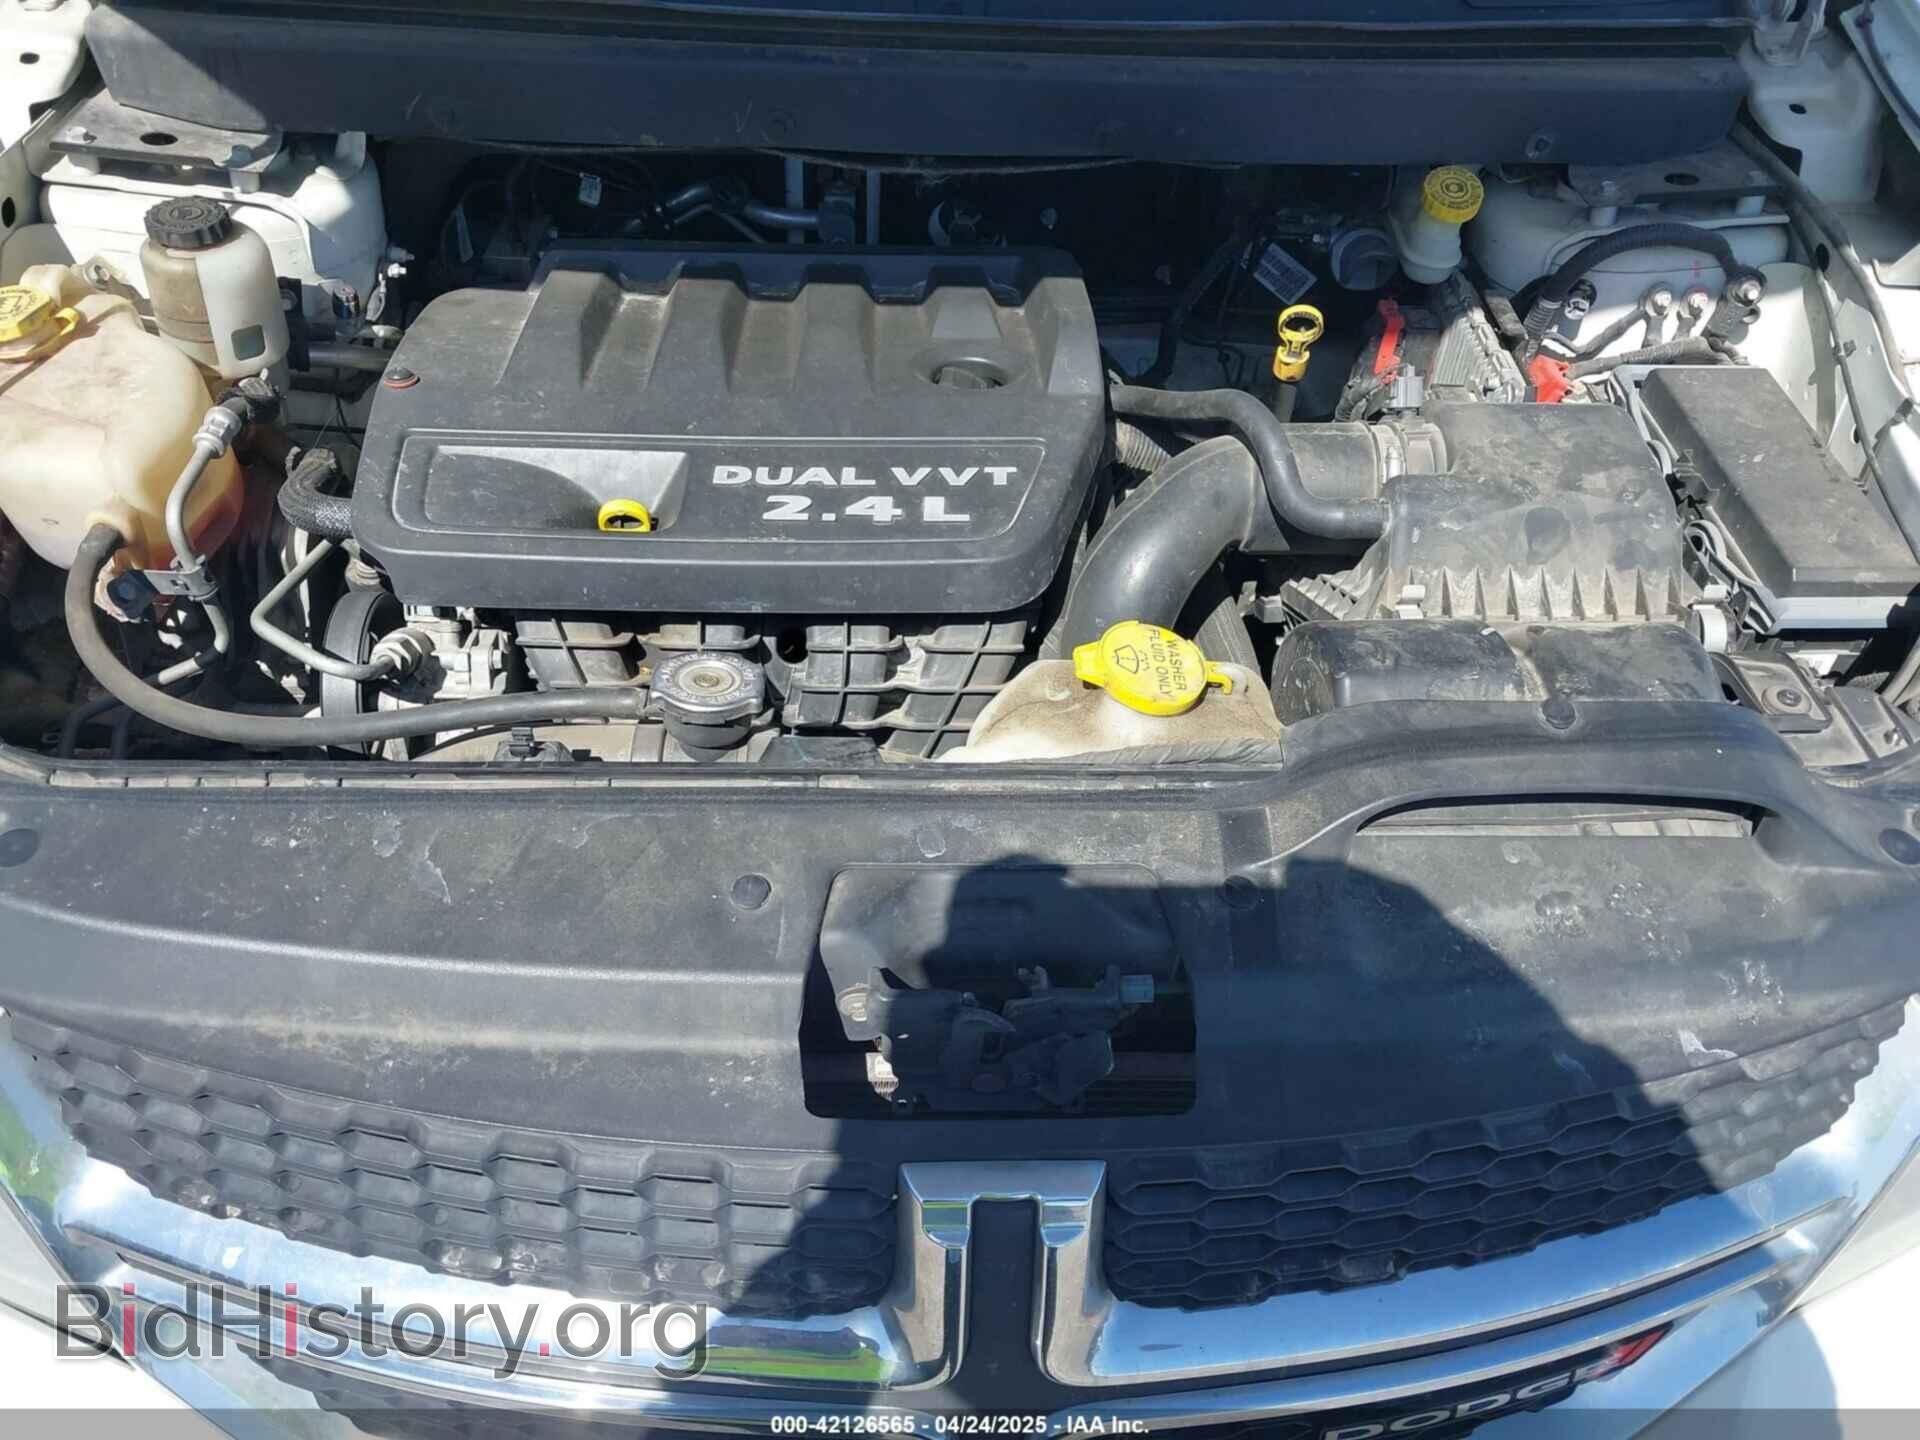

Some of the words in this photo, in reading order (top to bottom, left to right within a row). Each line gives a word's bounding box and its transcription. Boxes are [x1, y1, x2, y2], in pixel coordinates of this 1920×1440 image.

[712, 465, 877, 486] DUAL
[890, 466, 1018, 486] VVT
[1149, 628, 1166, 666] FLUID
[1165, 638, 1188, 691] WASHER
[1155, 665, 1173, 698] ONLY
